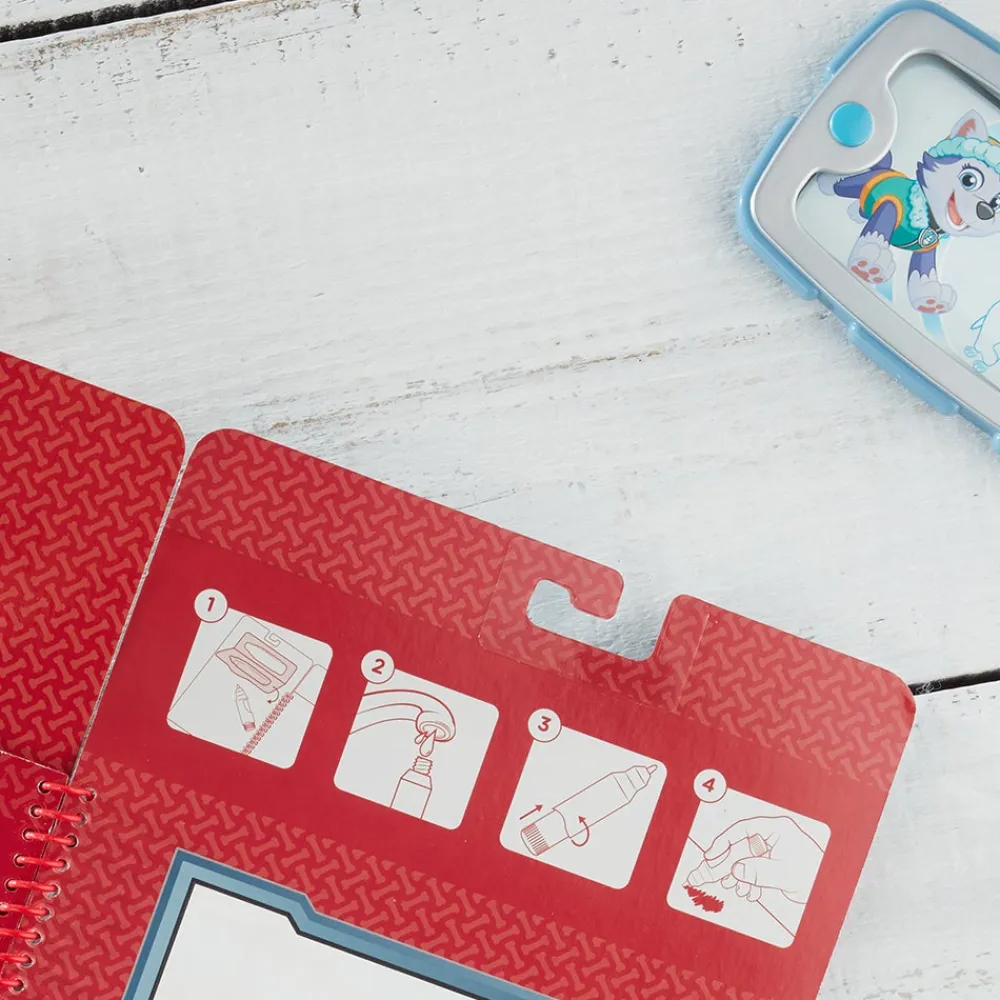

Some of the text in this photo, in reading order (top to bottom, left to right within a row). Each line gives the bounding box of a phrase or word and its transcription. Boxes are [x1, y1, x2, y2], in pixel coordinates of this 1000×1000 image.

[371, 658, 386, 675] 2
[537, 715, 552, 732] 3
[702, 777, 716, 793] 4
